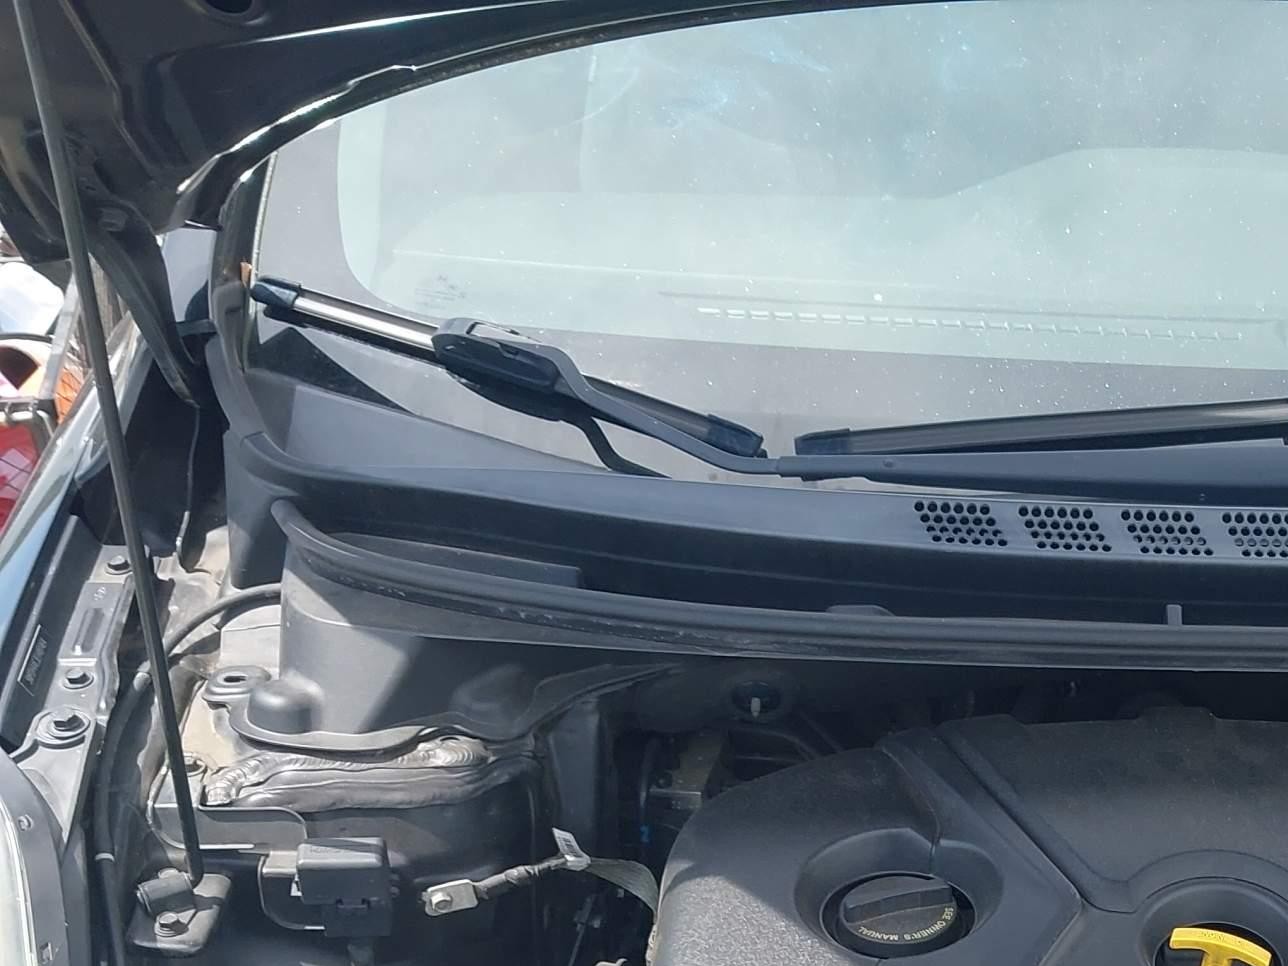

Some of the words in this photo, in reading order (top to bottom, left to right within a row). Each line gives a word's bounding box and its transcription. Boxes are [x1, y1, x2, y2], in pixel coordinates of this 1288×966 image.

[941, 907, 954, 921] SEE
[857, 926, 899, 941] MANUAL
[903, 920, 946, 940] OWNER'S
